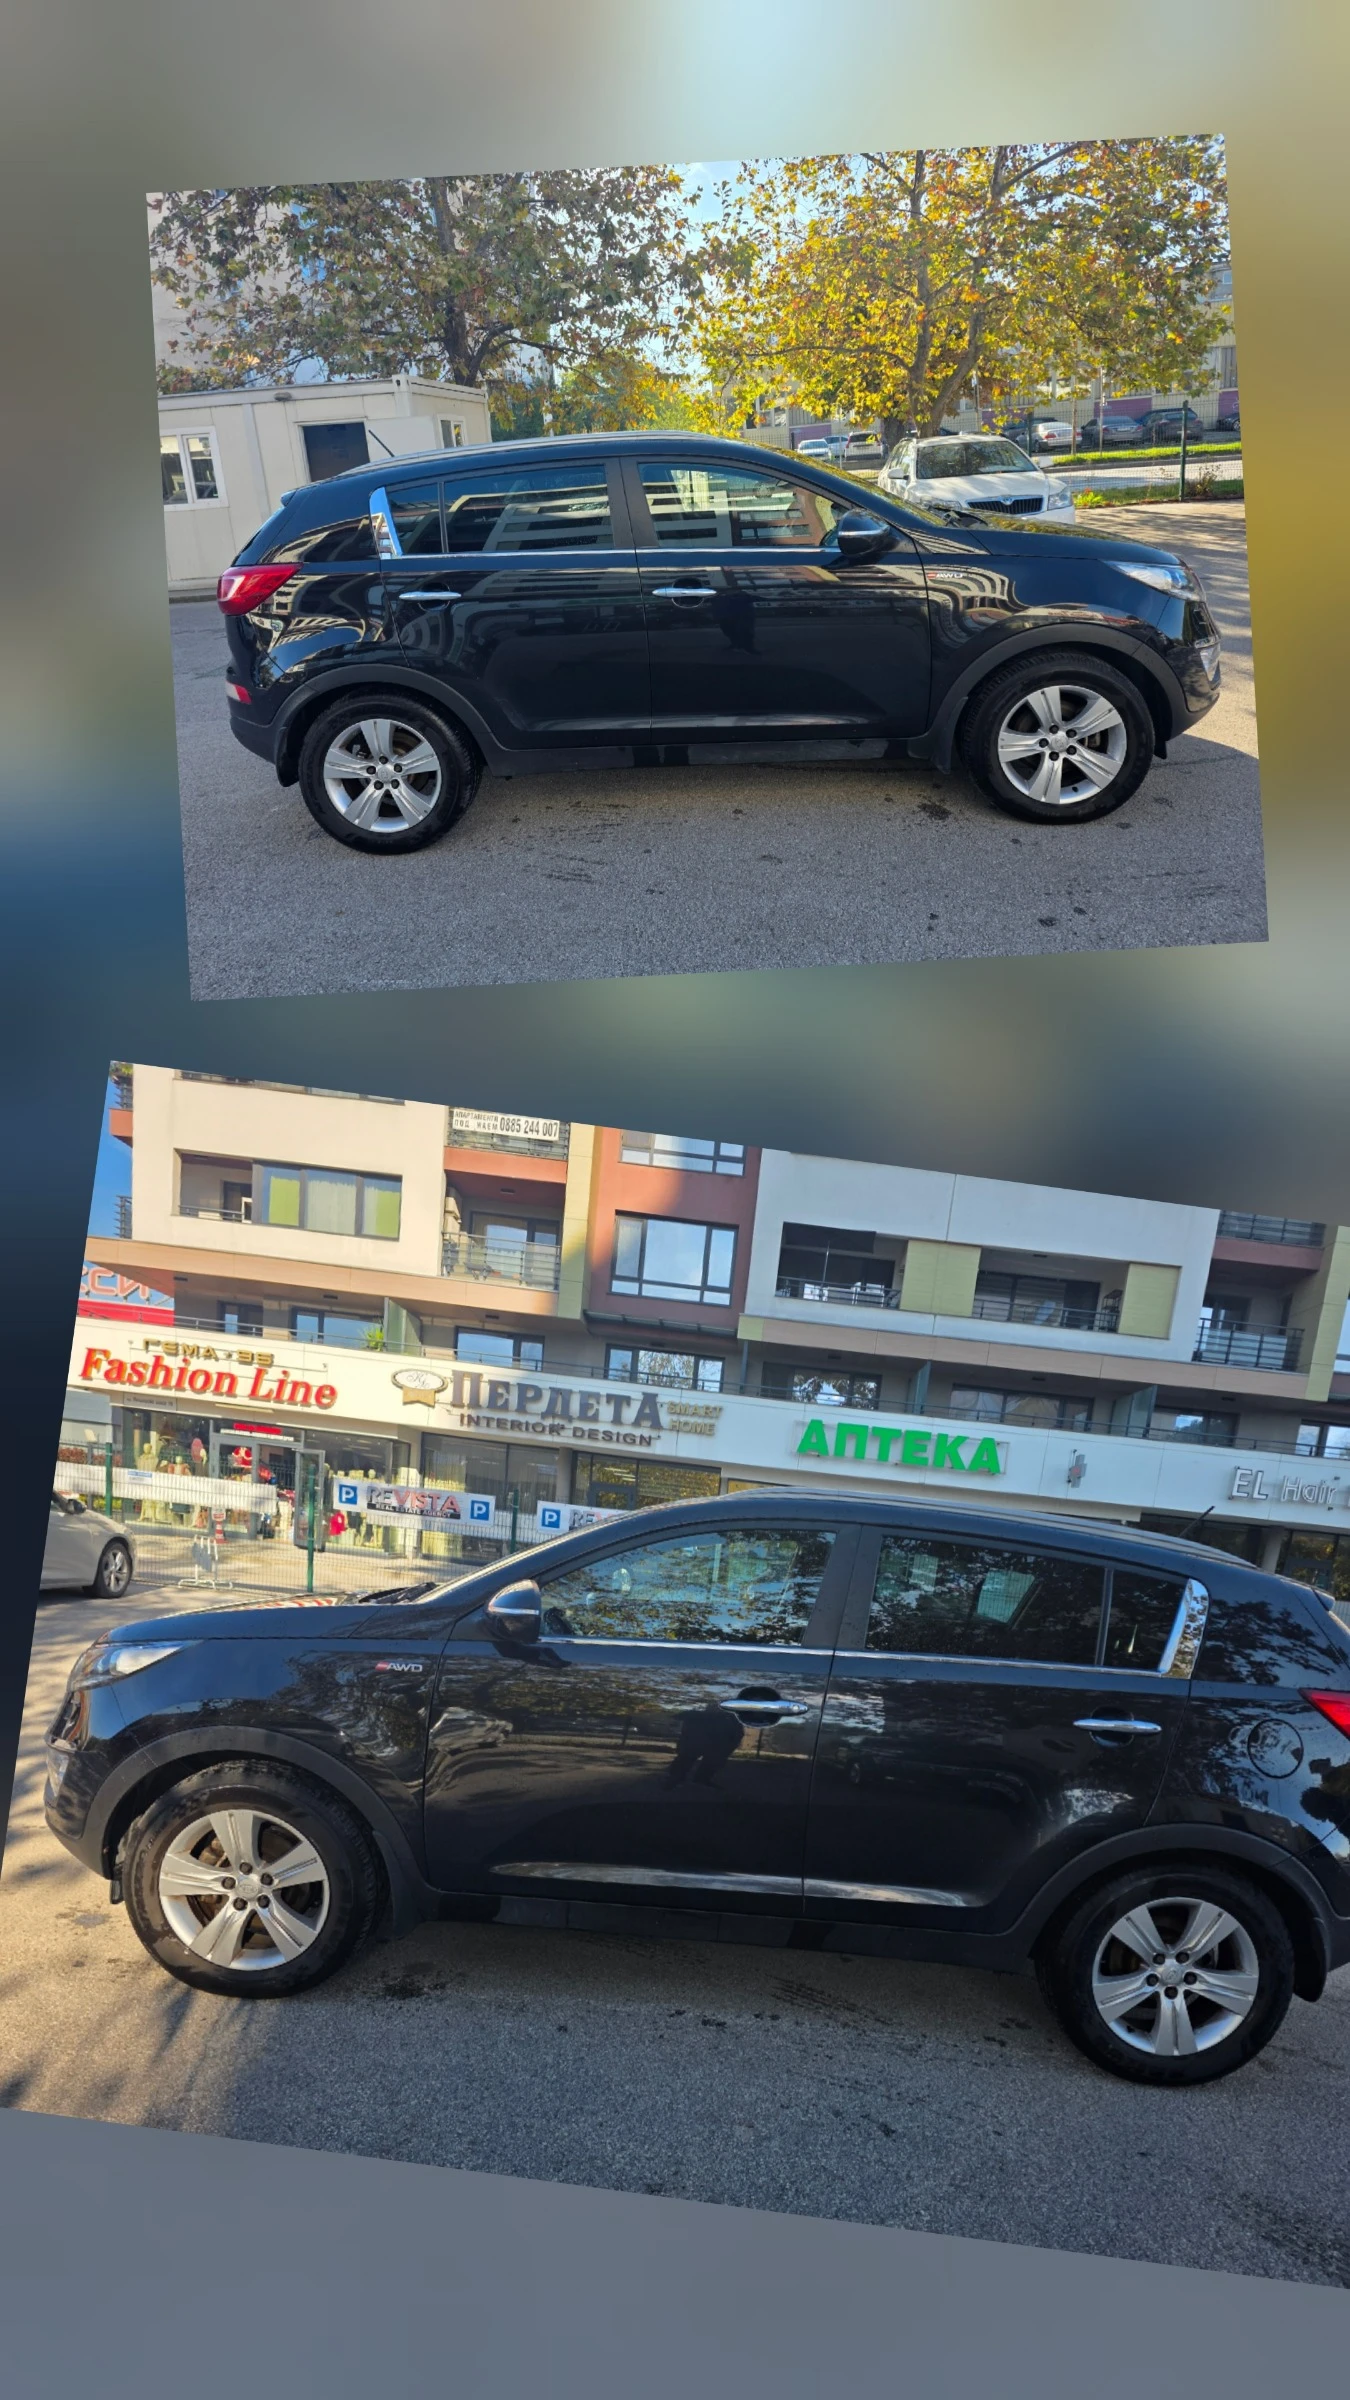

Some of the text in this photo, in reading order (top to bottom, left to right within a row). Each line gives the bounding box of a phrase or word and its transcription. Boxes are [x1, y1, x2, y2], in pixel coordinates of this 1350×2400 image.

[500, 1116, 559, 1138] 0885 244 007
[80, 1264, 149, 1301] СИ
[78, 1347, 338, 1408] Fashion Line
[450, 1369, 663, 1430] ПЕРДЕТА
[667, 1400, 723, 1419] SMART
[459, 1412, 653, 1447] INTERIOR DESIGN
[668, 1417, 716, 1437] HOME
[796, 1419, 1001, 1475] АПТЕКА
[341, 1486, 355, 1501] P
[1231, 1467, 1269, 1500] EL
[1280, 1475, 1337, 1504] Hair
[366, 1485, 461, 1513] REVISTA
[473, 1503, 486, 1517] P
[544, 1511, 558, 1525] P
[387, 1662, 423, 1673] AWD
